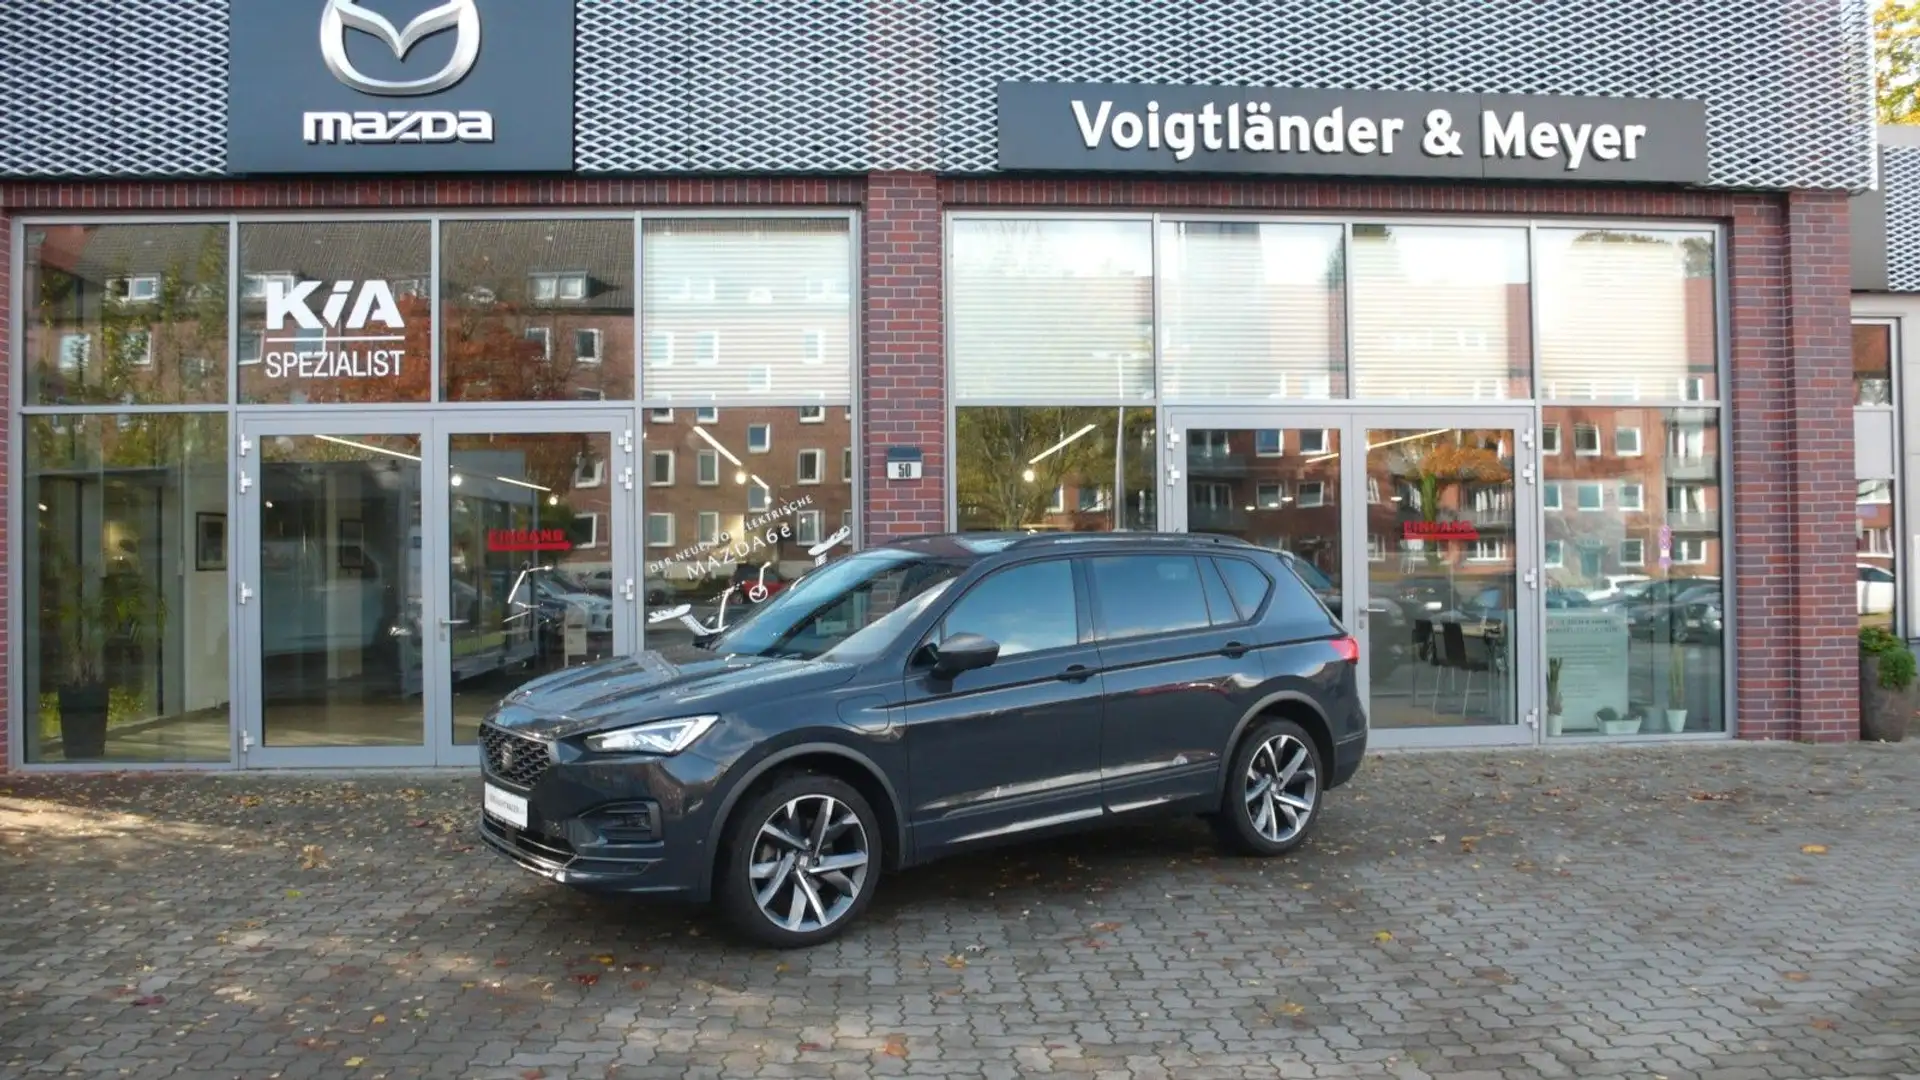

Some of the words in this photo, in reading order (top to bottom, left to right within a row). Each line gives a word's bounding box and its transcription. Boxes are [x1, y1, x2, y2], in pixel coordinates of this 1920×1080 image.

[1070, 99, 1404, 161] Voigtländer
[1422, 108, 1464, 157] &
[1482, 110, 1647, 171] Meyer
[265, 350, 405, 378] SPEZIALIST
[898, 463, 912, 478] 50
